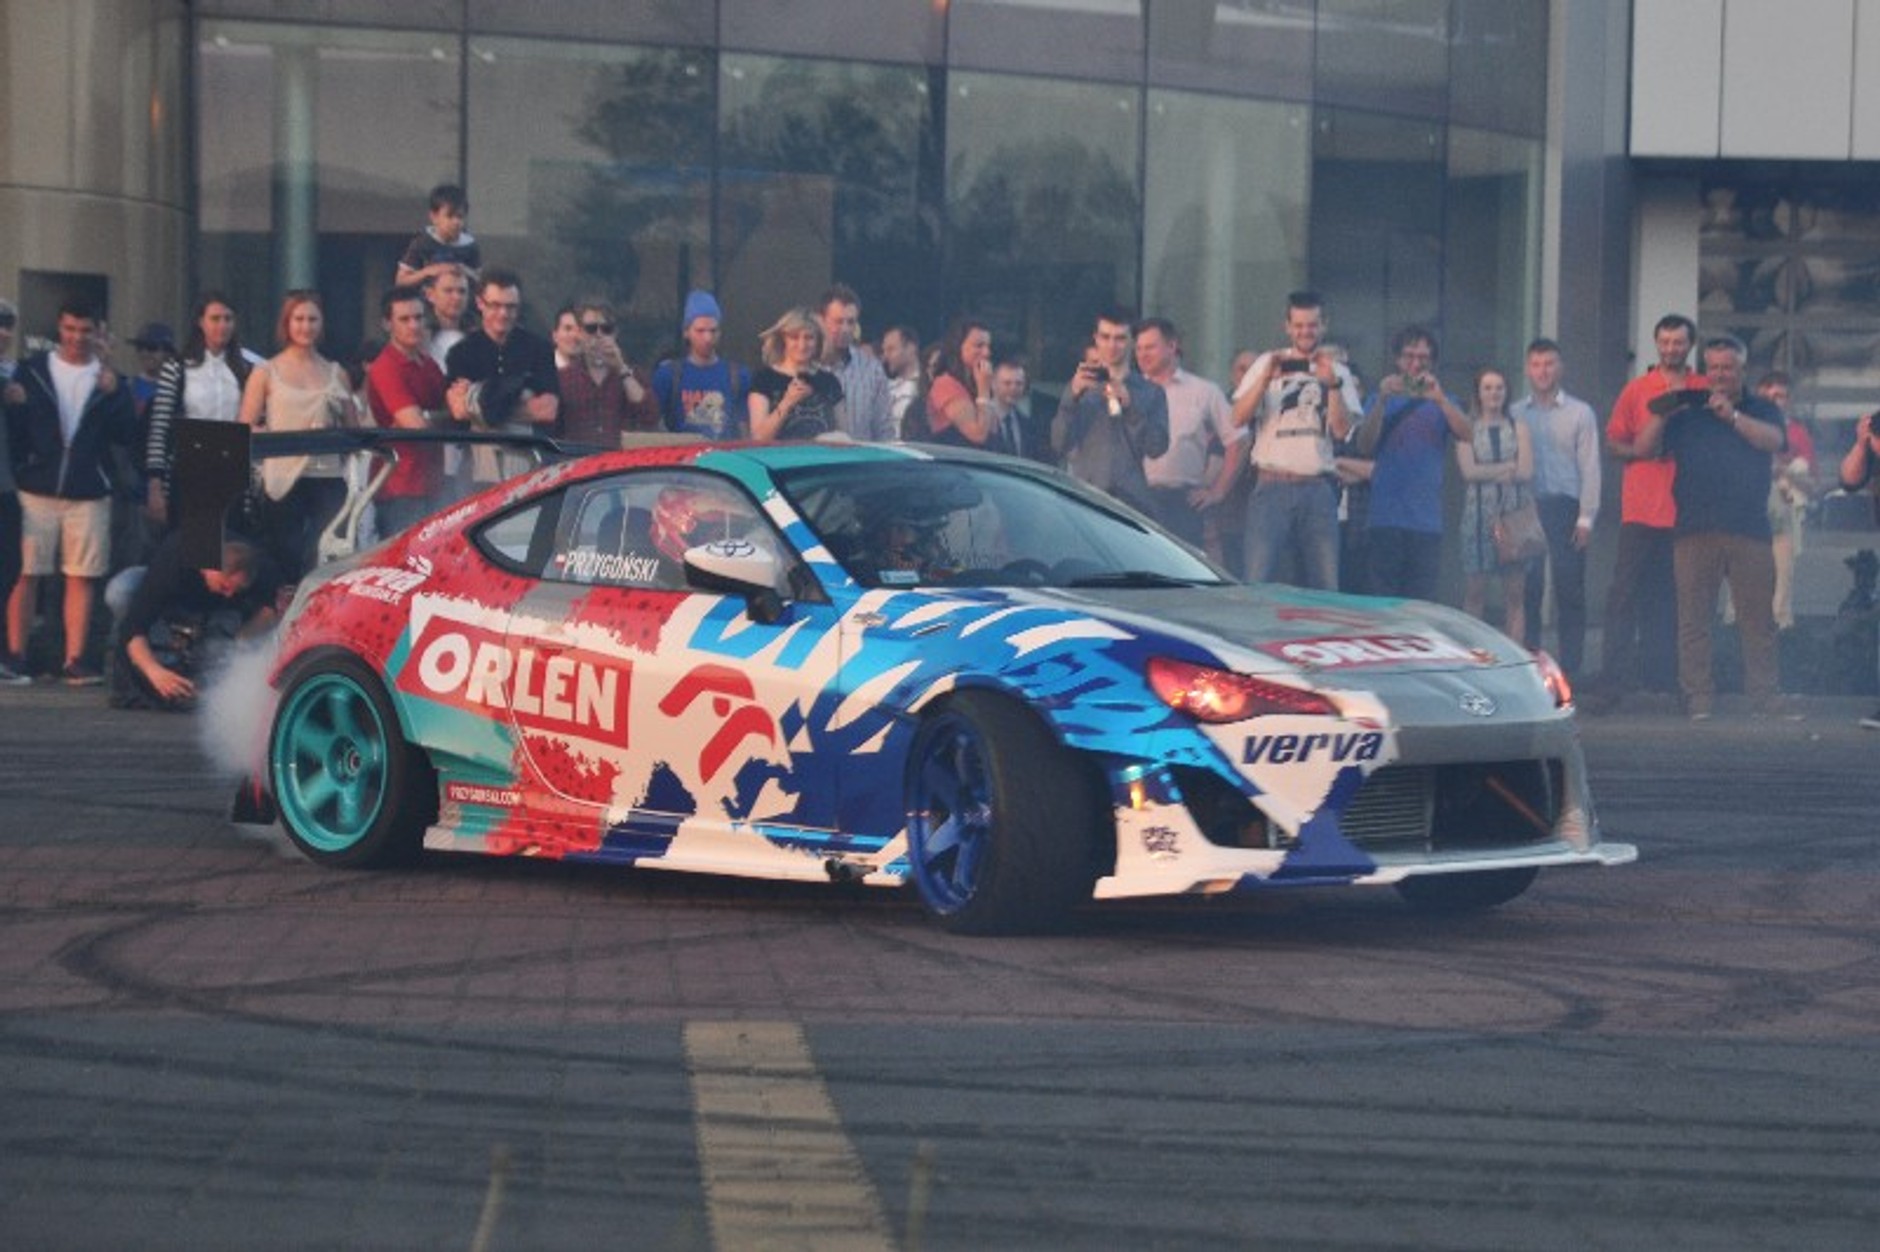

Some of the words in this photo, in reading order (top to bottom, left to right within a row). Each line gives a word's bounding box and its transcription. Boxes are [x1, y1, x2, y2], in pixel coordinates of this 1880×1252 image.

[564, 550, 660, 581] PRZYGOŃSKI
[418, 632, 619, 732] ORLEN
[1241, 732, 1384, 765] verva
